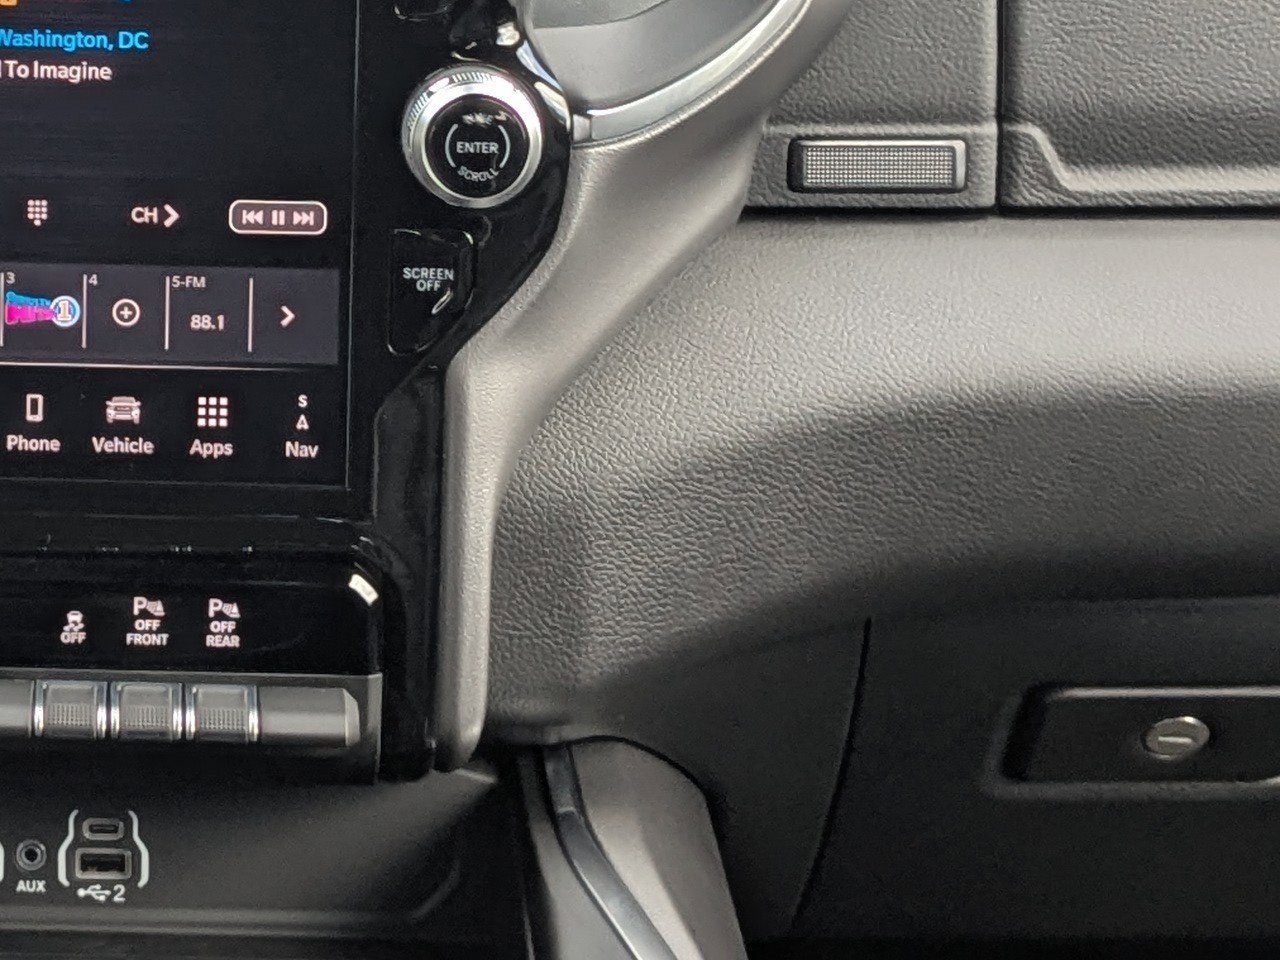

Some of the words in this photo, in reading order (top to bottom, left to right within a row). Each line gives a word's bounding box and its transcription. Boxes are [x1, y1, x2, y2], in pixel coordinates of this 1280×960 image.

[118, 31, 149, 49] DC
[4, 60, 29, 78] To
[33, 60, 113, 84] Imagine
[456, 141, 499, 154] ENTER
[457, 166, 499, 182] SCROLL
[131, 206, 159, 224] CH
[6, 272, 15, 284] 3
[89, 274, 98, 286] 4
[402, 268, 454, 280] SCREEN
[172, 276, 206, 288] 5-FM
[416, 279, 441, 291] OFF
[58, 301, 71, 321] 1
[190, 314, 225, 331] 88.1
[298, 394, 308, 408] S
[6, 434, 61, 452] Phone
[91, 436, 155, 454] Vehicle
[190, 439, 234, 459] Apps
[285, 441, 319, 458] Nav
[134, 619, 161, 631] OFF
[210, 621, 236, 633] OFF
[60, 631, 87, 644] OFF
[126, 633, 169, 646] FRONT
[206, 635, 240, 648] REAR
[16, 880, 47, 893] AUX
[113, 884, 126, 903] 2
